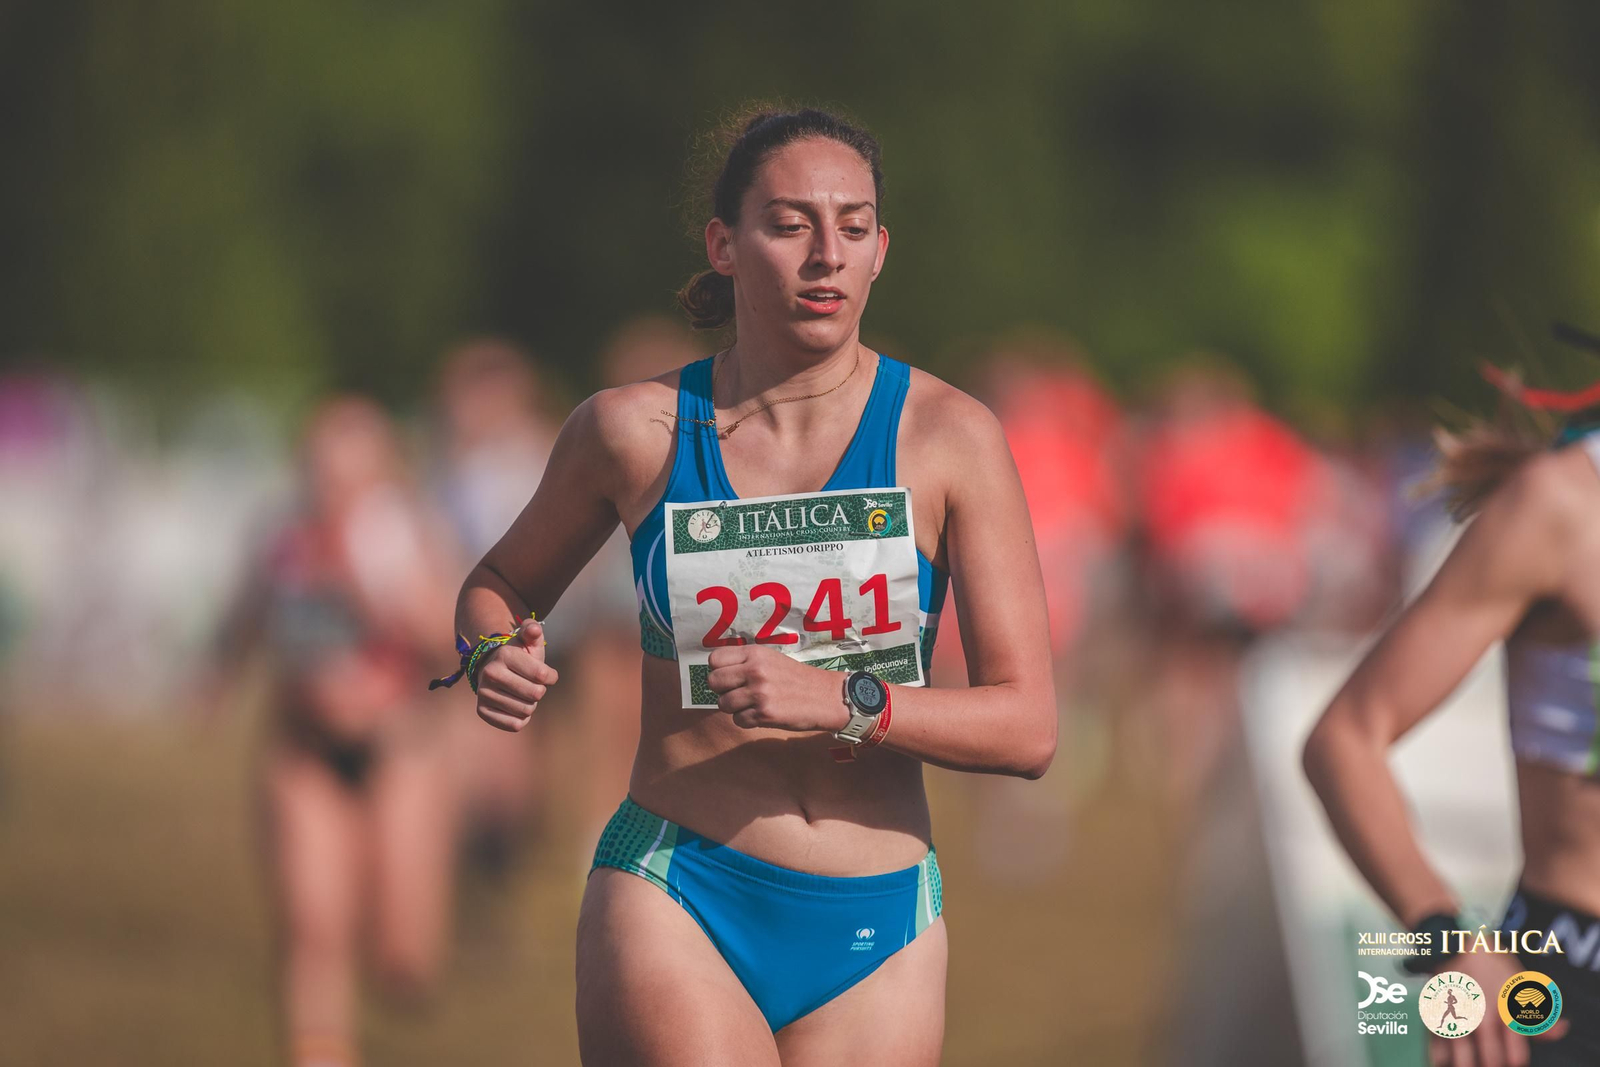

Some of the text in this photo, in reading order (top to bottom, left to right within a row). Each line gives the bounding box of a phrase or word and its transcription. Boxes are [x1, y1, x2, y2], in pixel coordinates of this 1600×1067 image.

[738, 503, 851, 534] ITÁLICA
[739, 531, 794, 540] INTERNATIONAL
[745, 543, 844, 558] ATLETISMO ORIPPO
[696, 573, 902, 648] 2241
[872, 658, 908, 671] docunova
